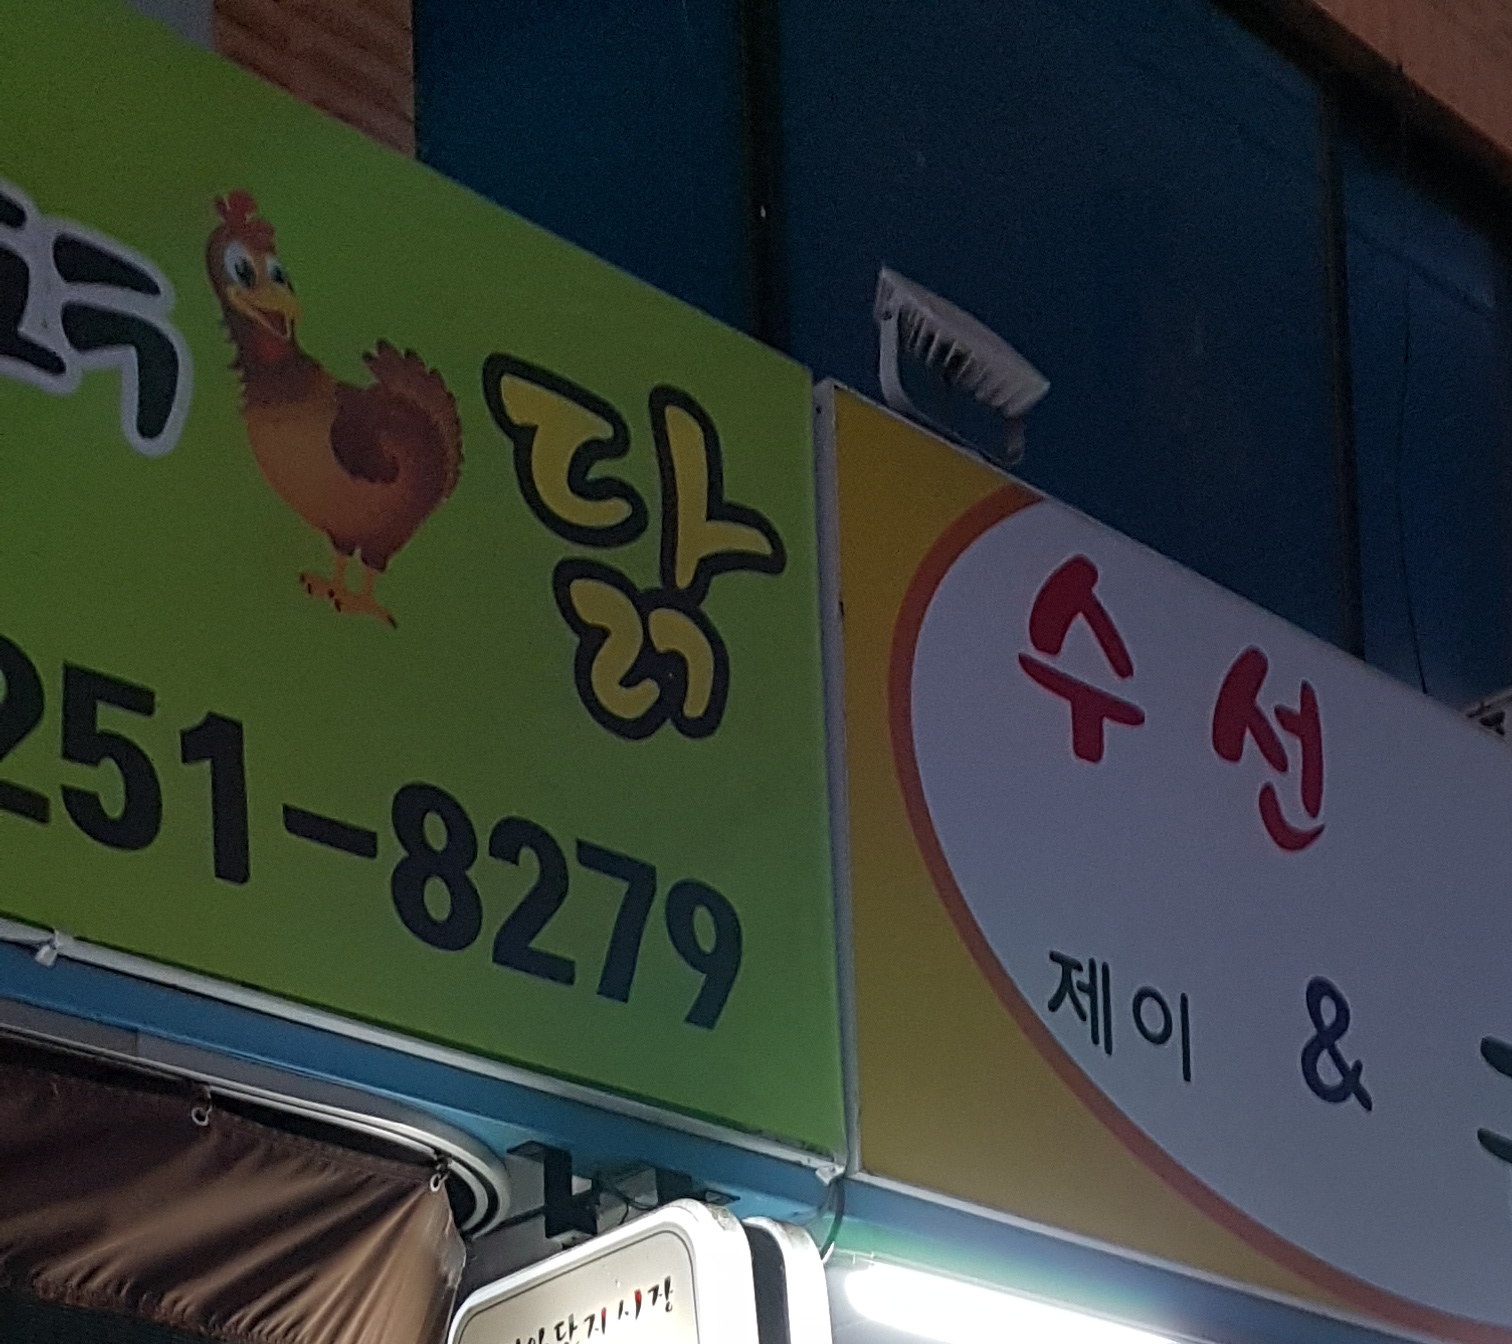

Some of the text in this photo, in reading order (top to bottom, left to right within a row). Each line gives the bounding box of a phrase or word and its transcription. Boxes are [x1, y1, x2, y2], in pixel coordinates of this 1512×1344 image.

[482, 352, 787, 741] 닭
[1018, 553, 1328, 852] 수선
[1046, 948, 1193, 1081] 제이
[1299, 976, 1373, 1111] &
